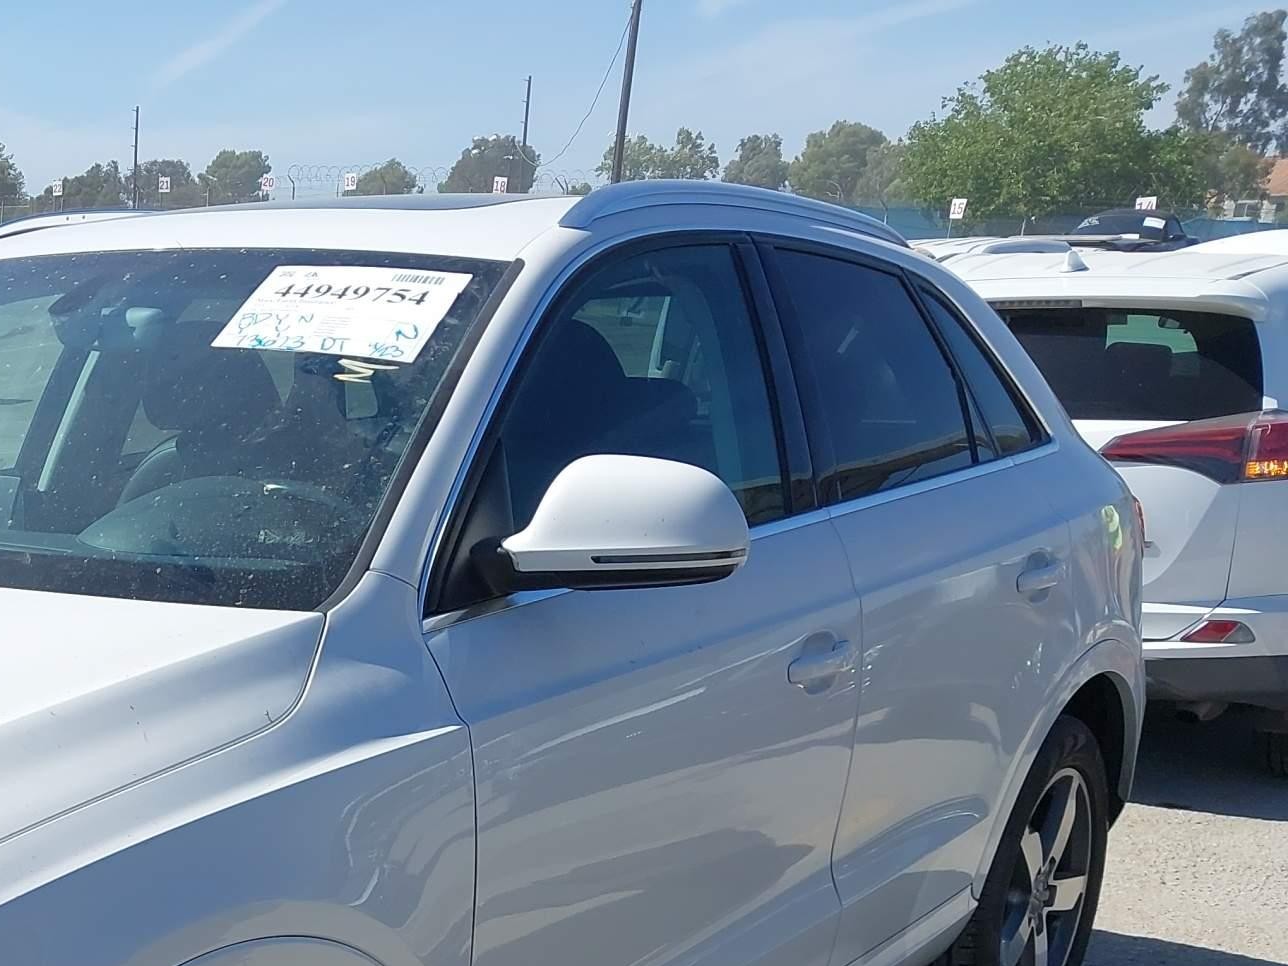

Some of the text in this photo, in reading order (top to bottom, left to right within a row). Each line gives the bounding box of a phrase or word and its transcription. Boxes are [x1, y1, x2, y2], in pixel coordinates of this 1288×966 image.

[160, 181, 168, 190] 21
[263, 177, 274, 187] 20
[345, 176, 355, 186] 19
[494, 180, 505, 192] 18
[53, 184, 62, 193] 22
[952, 202, 964, 214] 15
[275, 283, 429, 306] 44949754
